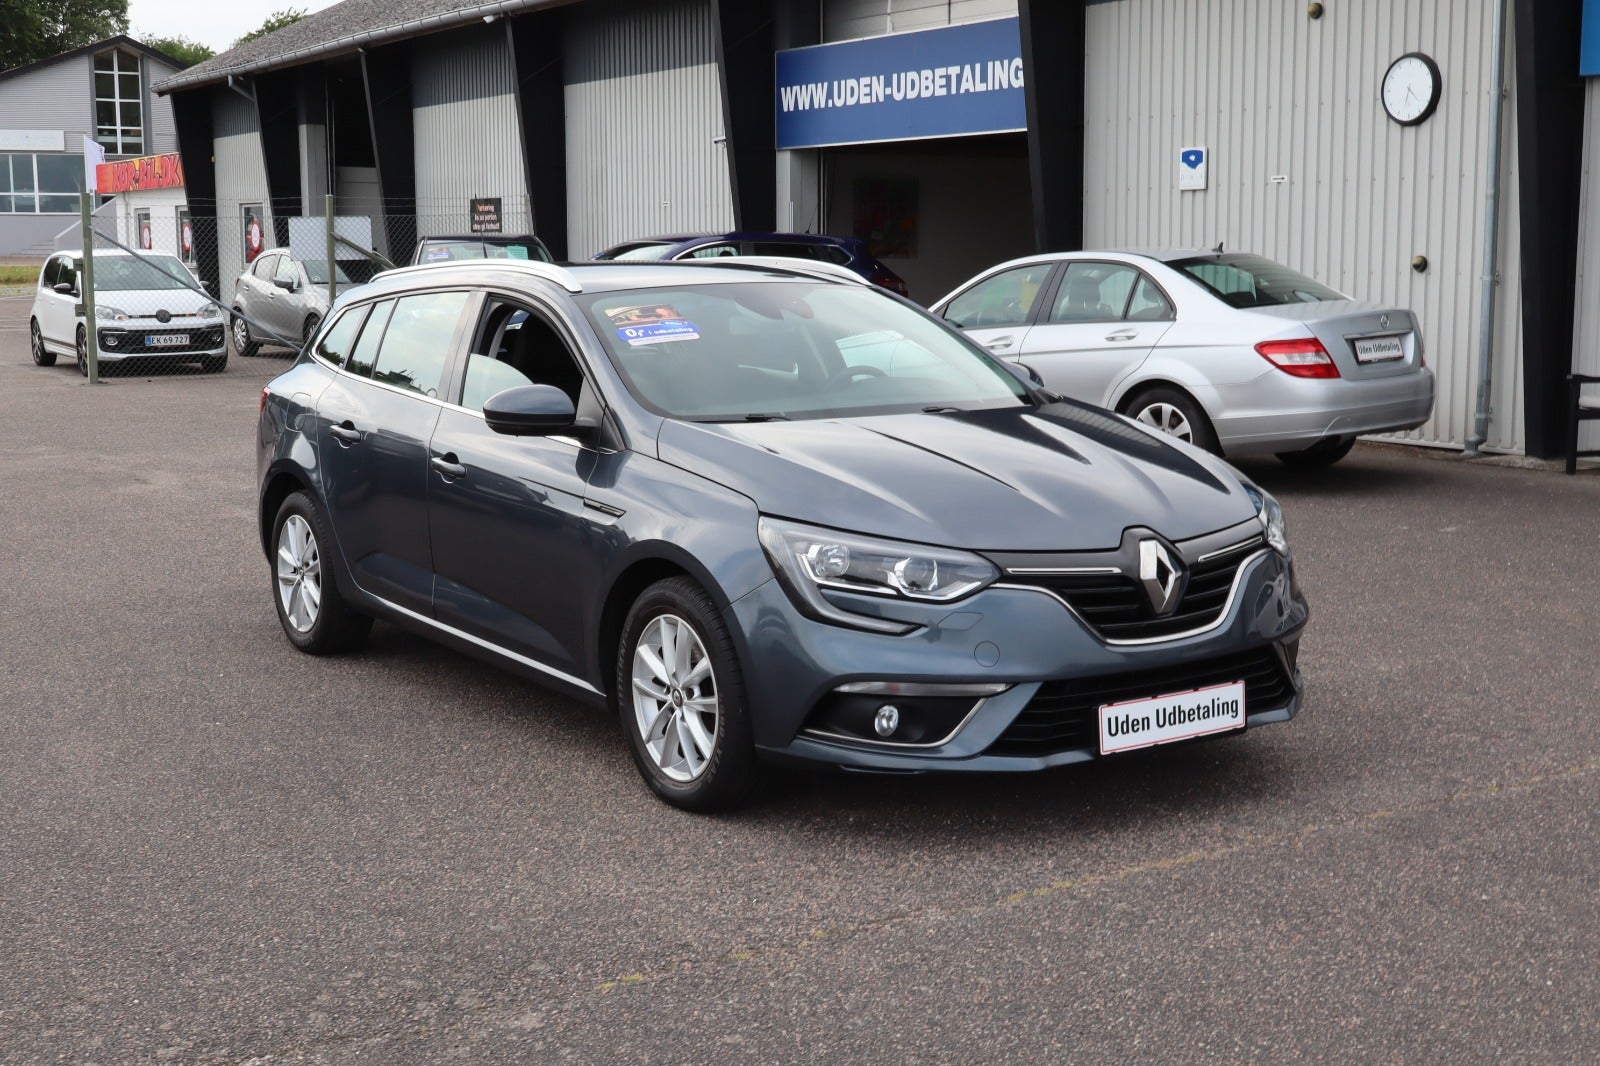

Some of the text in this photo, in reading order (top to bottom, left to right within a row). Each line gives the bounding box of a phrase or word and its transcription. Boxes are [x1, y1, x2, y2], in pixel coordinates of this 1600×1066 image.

[781, 57, 1024, 112] WWW.UDEN-UDBETALING
[152, 336, 188, 344] EK 69 727
[1107, 697, 1239, 737] Uden Udbetaling
